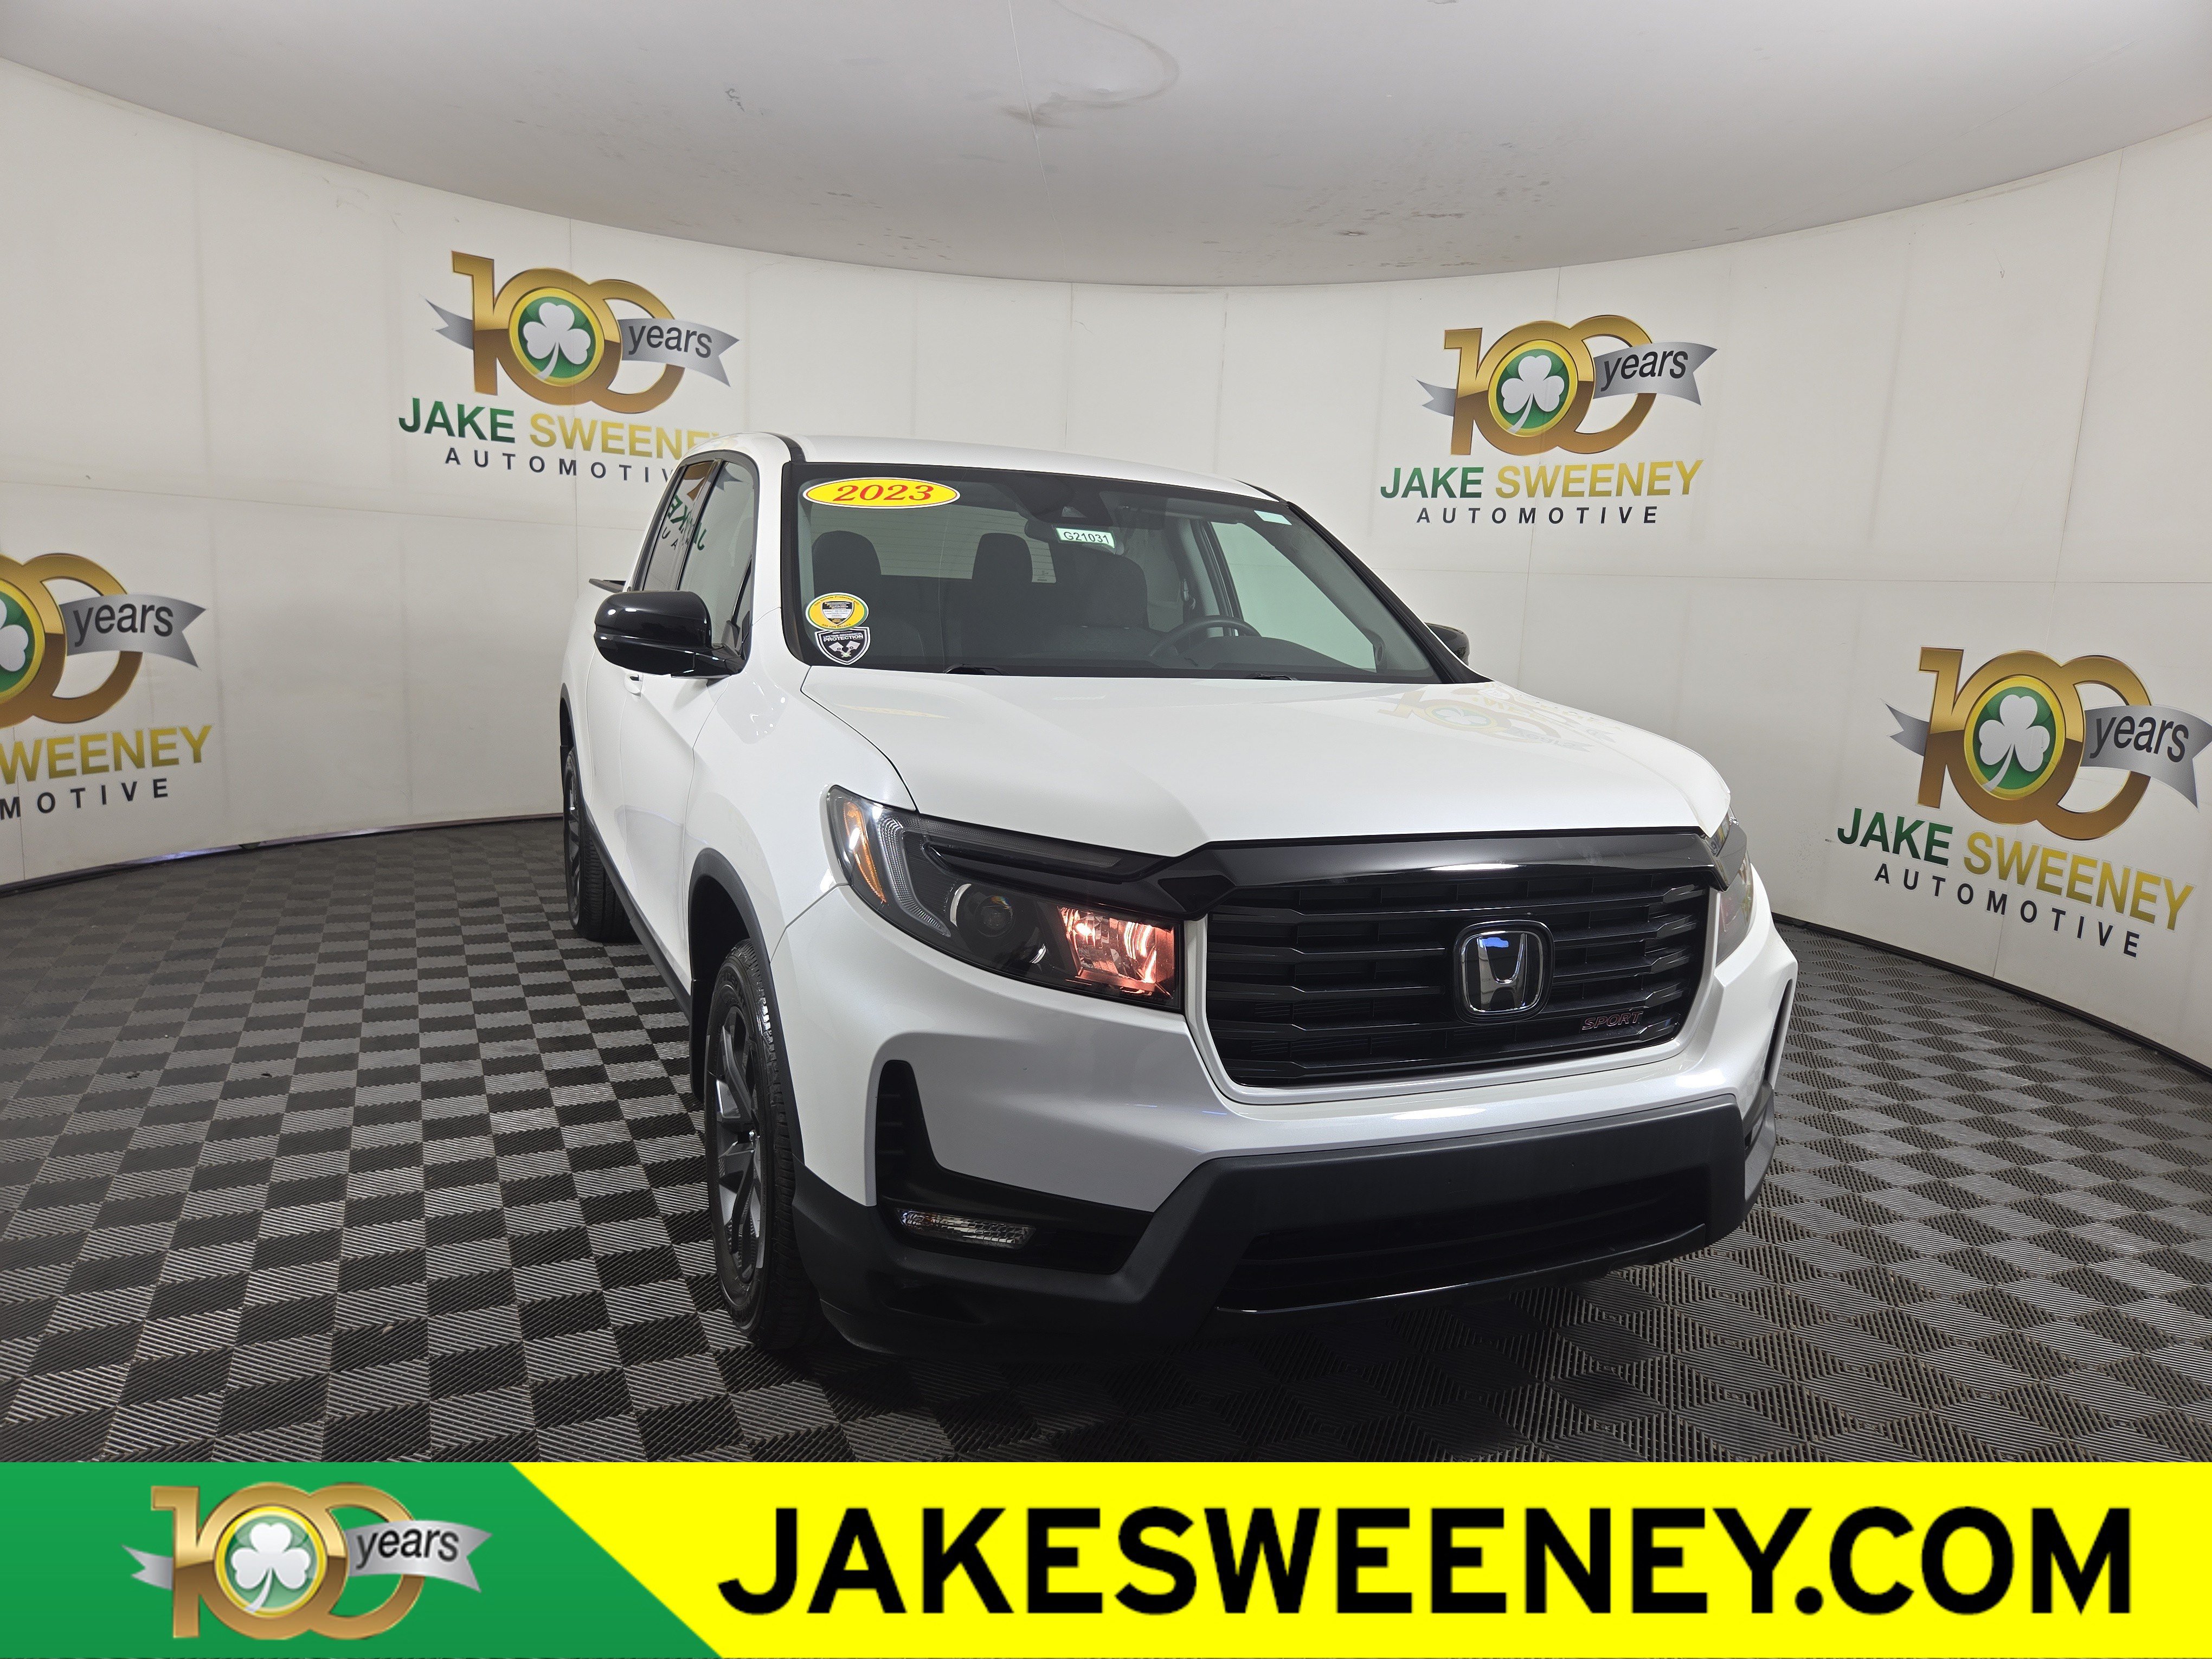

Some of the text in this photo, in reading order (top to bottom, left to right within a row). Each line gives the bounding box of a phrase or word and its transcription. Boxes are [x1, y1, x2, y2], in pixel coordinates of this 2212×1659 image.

[452, 250, 712, 414] 100 years
[1444, 314, 1688, 456] 100 years
[398, 396, 516, 443] JAKE
[833, 485, 934, 501] 2023
[1380, 459, 1703, 498] JAKE SWEENEY
[1416, 505, 1657, 524] AUTOMOTIVE
[1063, 531, 1109, 544] G21031
[73, 603, 174, 647] years
[0, 725, 212, 785] WEENEY
[1917, 646, 2189, 841] 100 years
[0, 777, 169, 820] MOTIVE
[1837, 807, 2195, 931] JAKE SWEENEY
[1874, 863, 2140, 959] AUTOMOTIVE
[1581, 1011, 1644, 1030] SPORT
